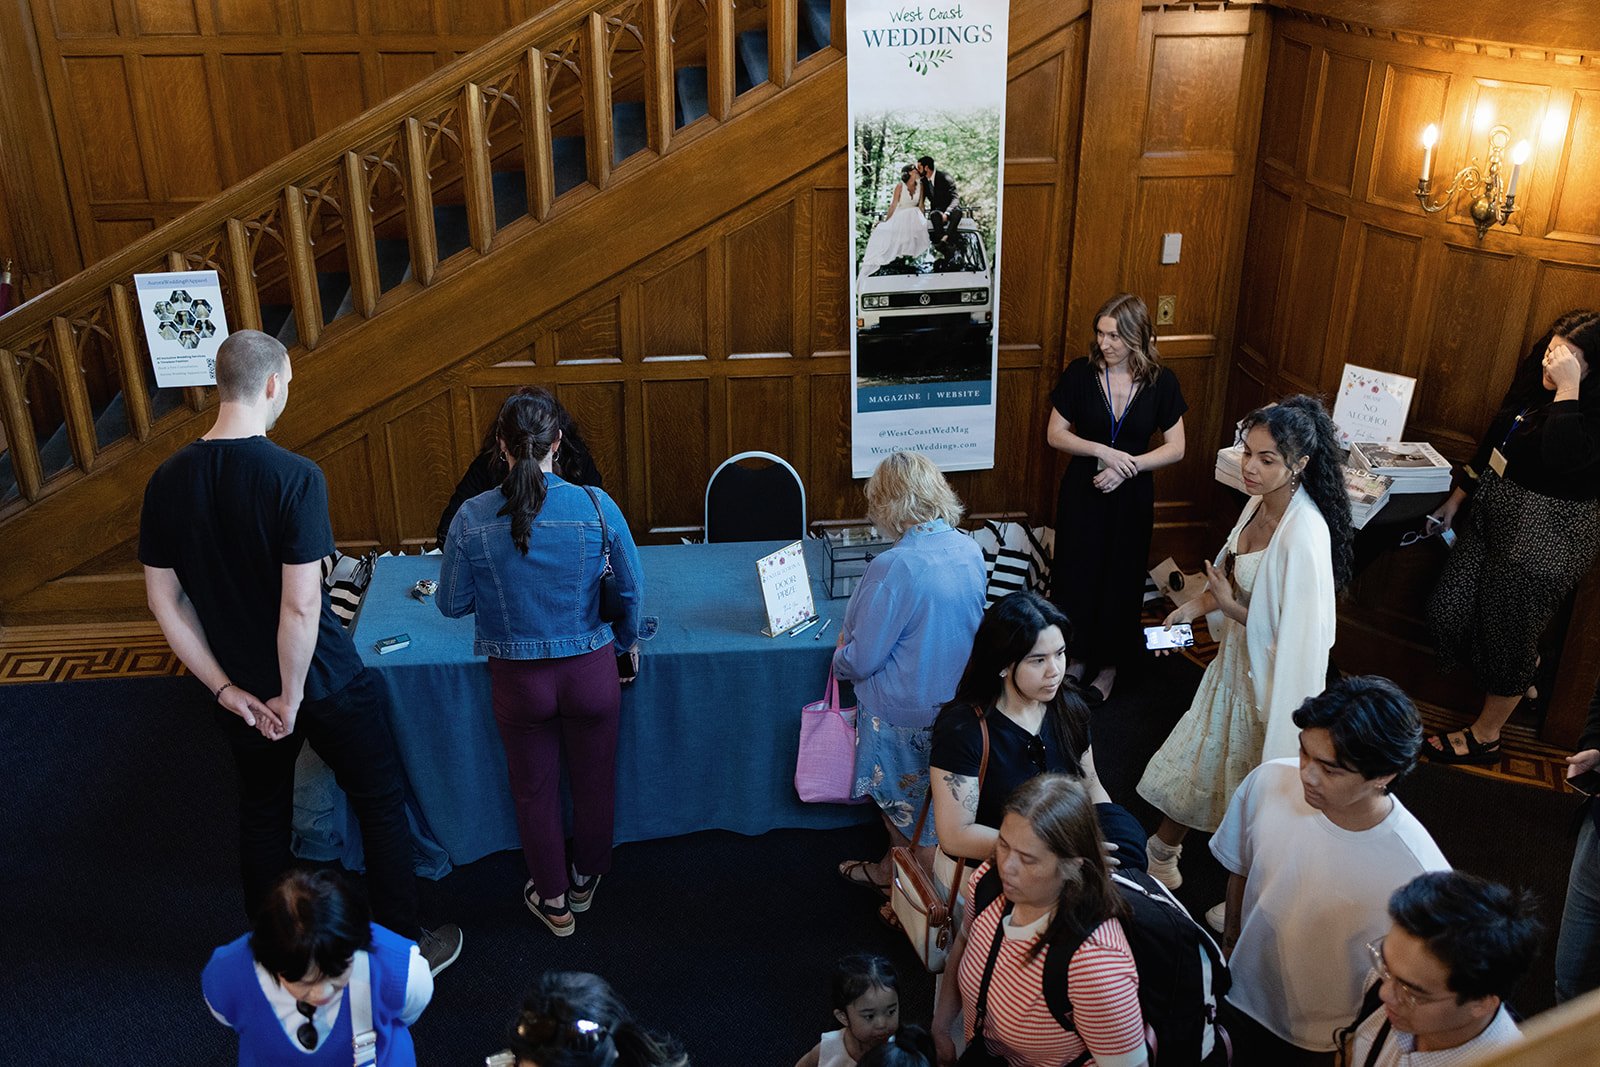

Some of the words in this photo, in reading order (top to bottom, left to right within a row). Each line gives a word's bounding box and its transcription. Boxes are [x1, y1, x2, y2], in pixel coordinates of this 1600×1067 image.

[889, 6, 924, 23] West
[929, 4, 964, 21] Coast
[862, 24, 993, 48] WEDDINGS
[868, 393, 921, 404] MAGAZINE
[936, 390, 981, 399] WEBSITE
[879, 426, 969, 437] @WestCoastWedMag
[870, 442, 977, 454] WestCoastWeddings.com
